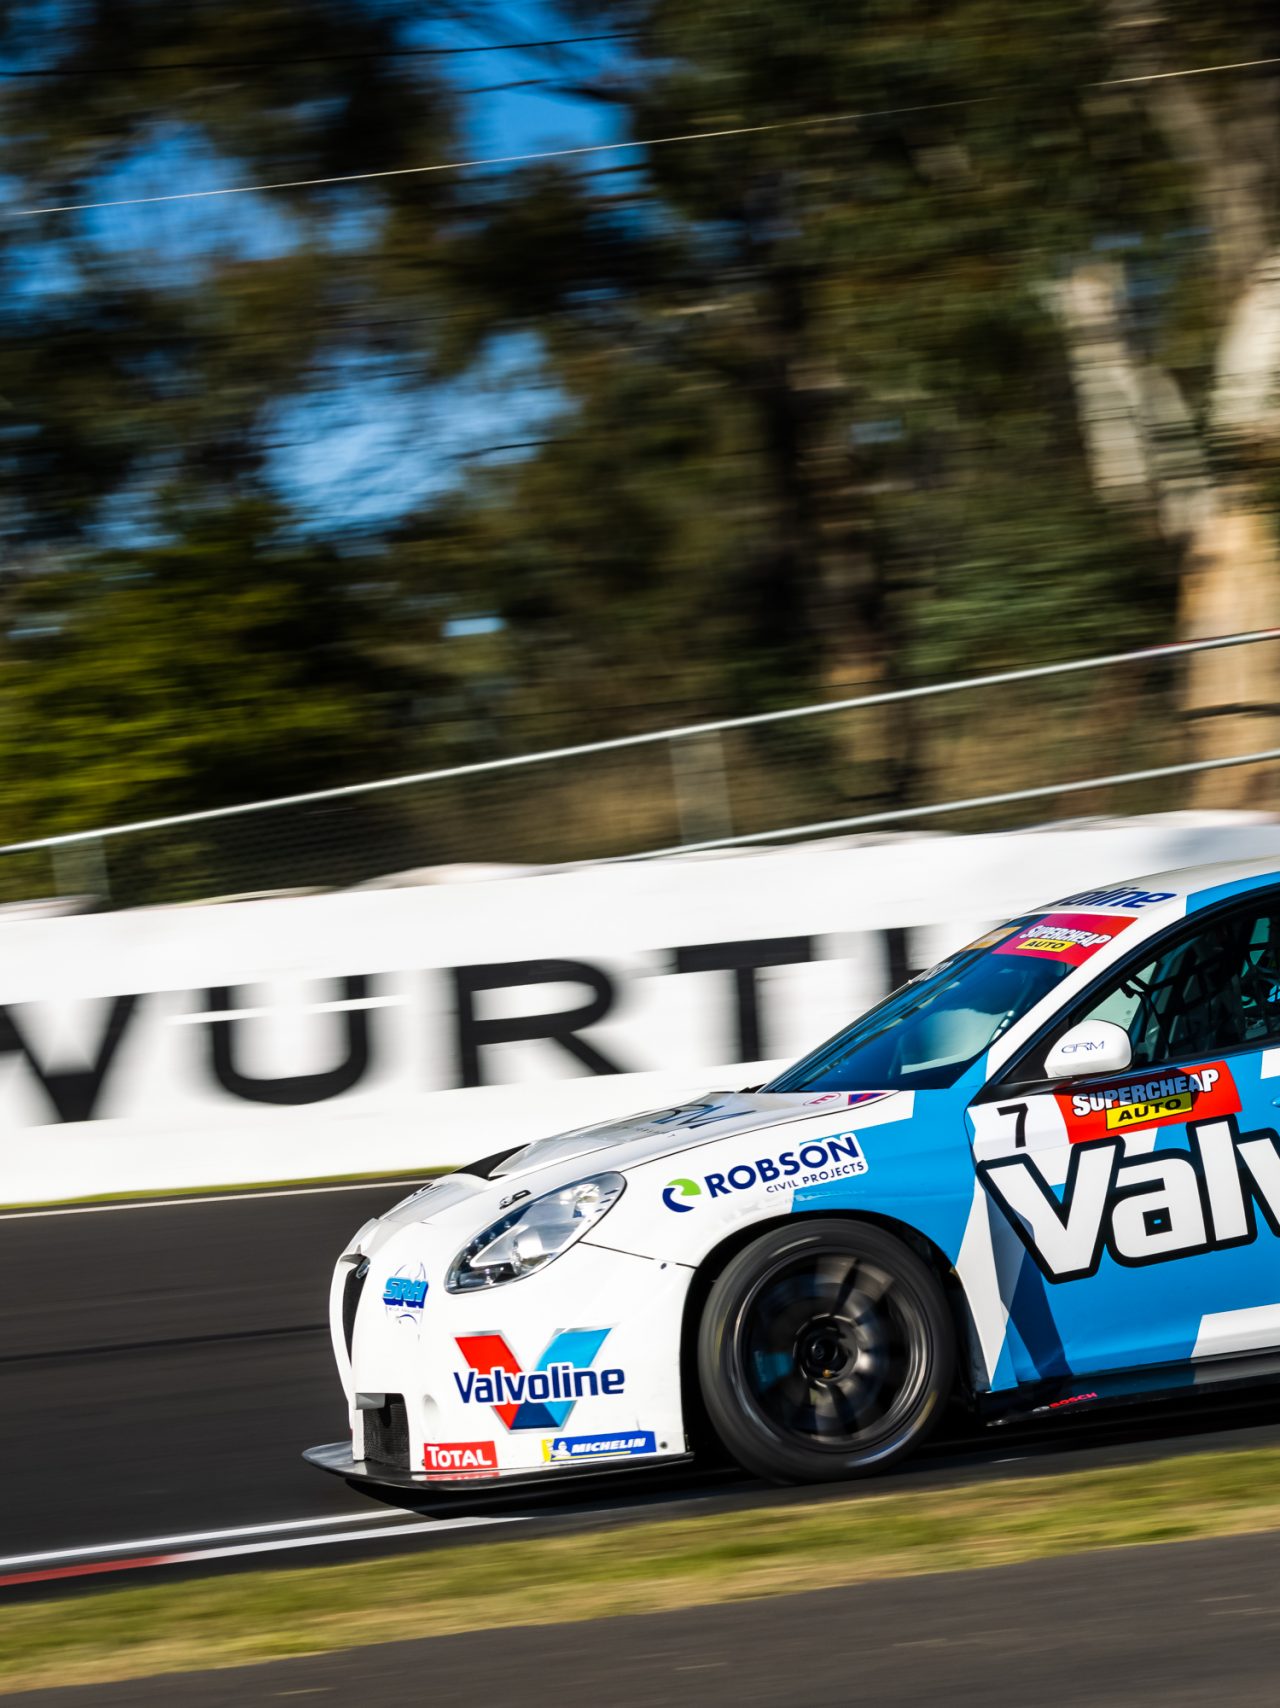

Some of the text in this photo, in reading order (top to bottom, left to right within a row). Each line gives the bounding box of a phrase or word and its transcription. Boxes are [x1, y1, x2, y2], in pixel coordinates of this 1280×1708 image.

[1019, 925, 1113, 947] SUPERCHEAP
[1025, 940, 1066, 949] AUTO
[1072, 1069, 1220, 1117] SUPERCHEAP
[1118, 1098, 1182, 1122] AUTO
[997, 1103, 1028, 1148] 7
[704, 1136, 859, 1198] ROBSON
[766, 1162, 865, 1193] CIVIL PROJECTS
[453, 1365, 625, 1404] Valvoline
[1049, 1392, 1098, 1408] BOSCH
[427, 1445, 492, 1467] TOTAL
[571, 1437, 646, 1453] MICHELIN
